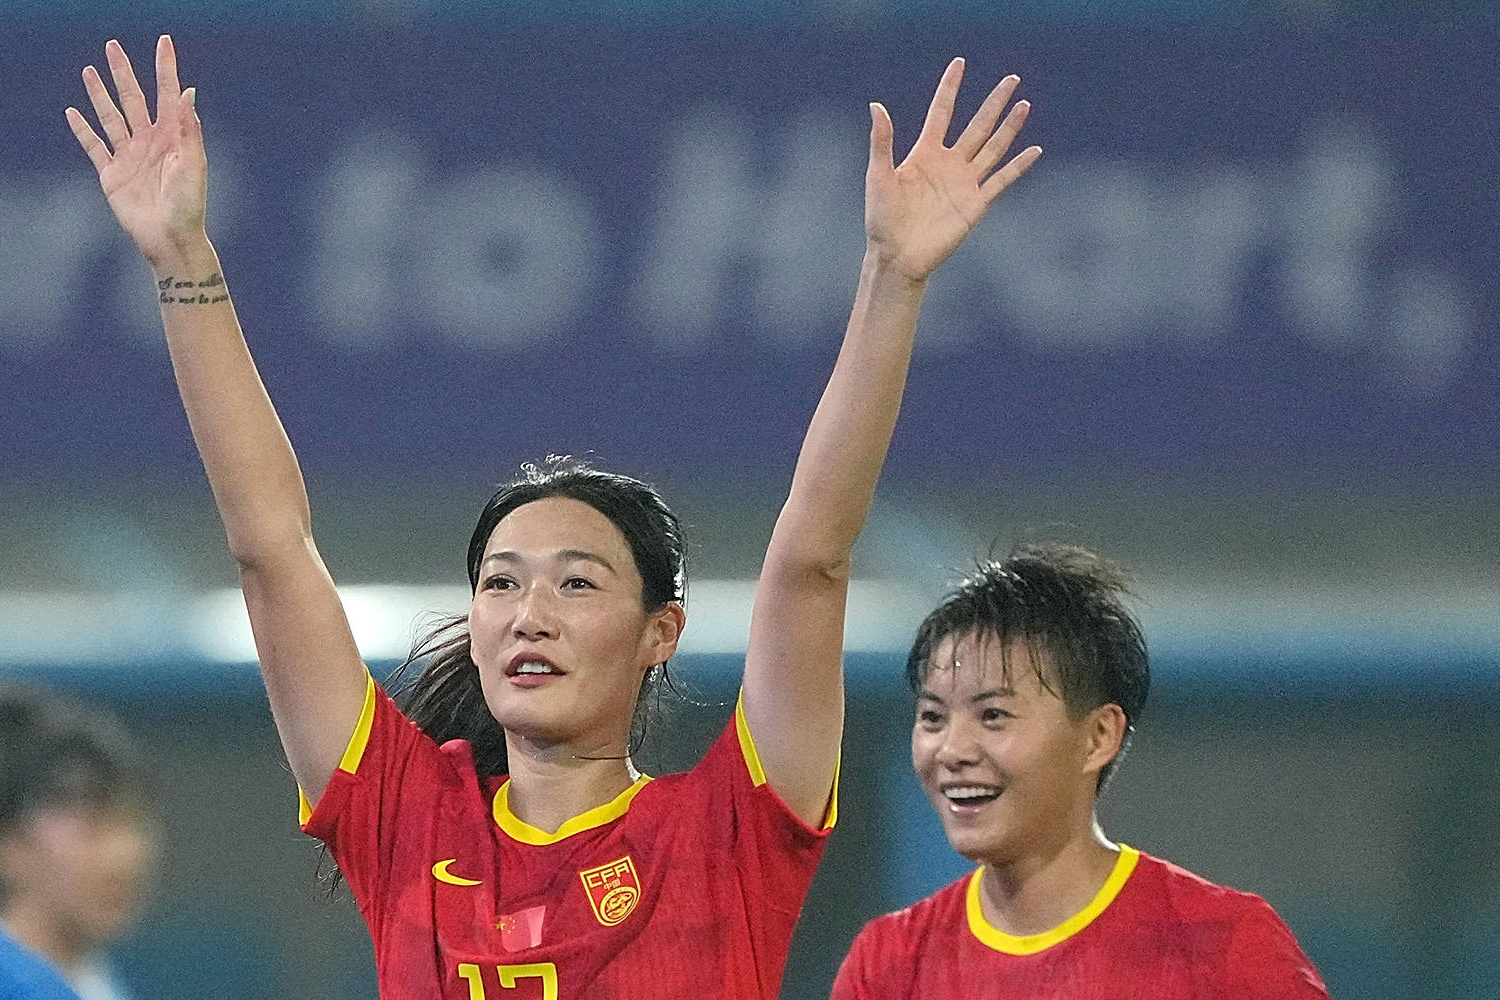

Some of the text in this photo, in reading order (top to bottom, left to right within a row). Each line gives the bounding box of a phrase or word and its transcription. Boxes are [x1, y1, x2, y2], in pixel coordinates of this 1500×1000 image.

[308, 124, 604, 355] to
[640, 105, 1465, 390] Hart,
[586, 862, 630, 888] CFA
